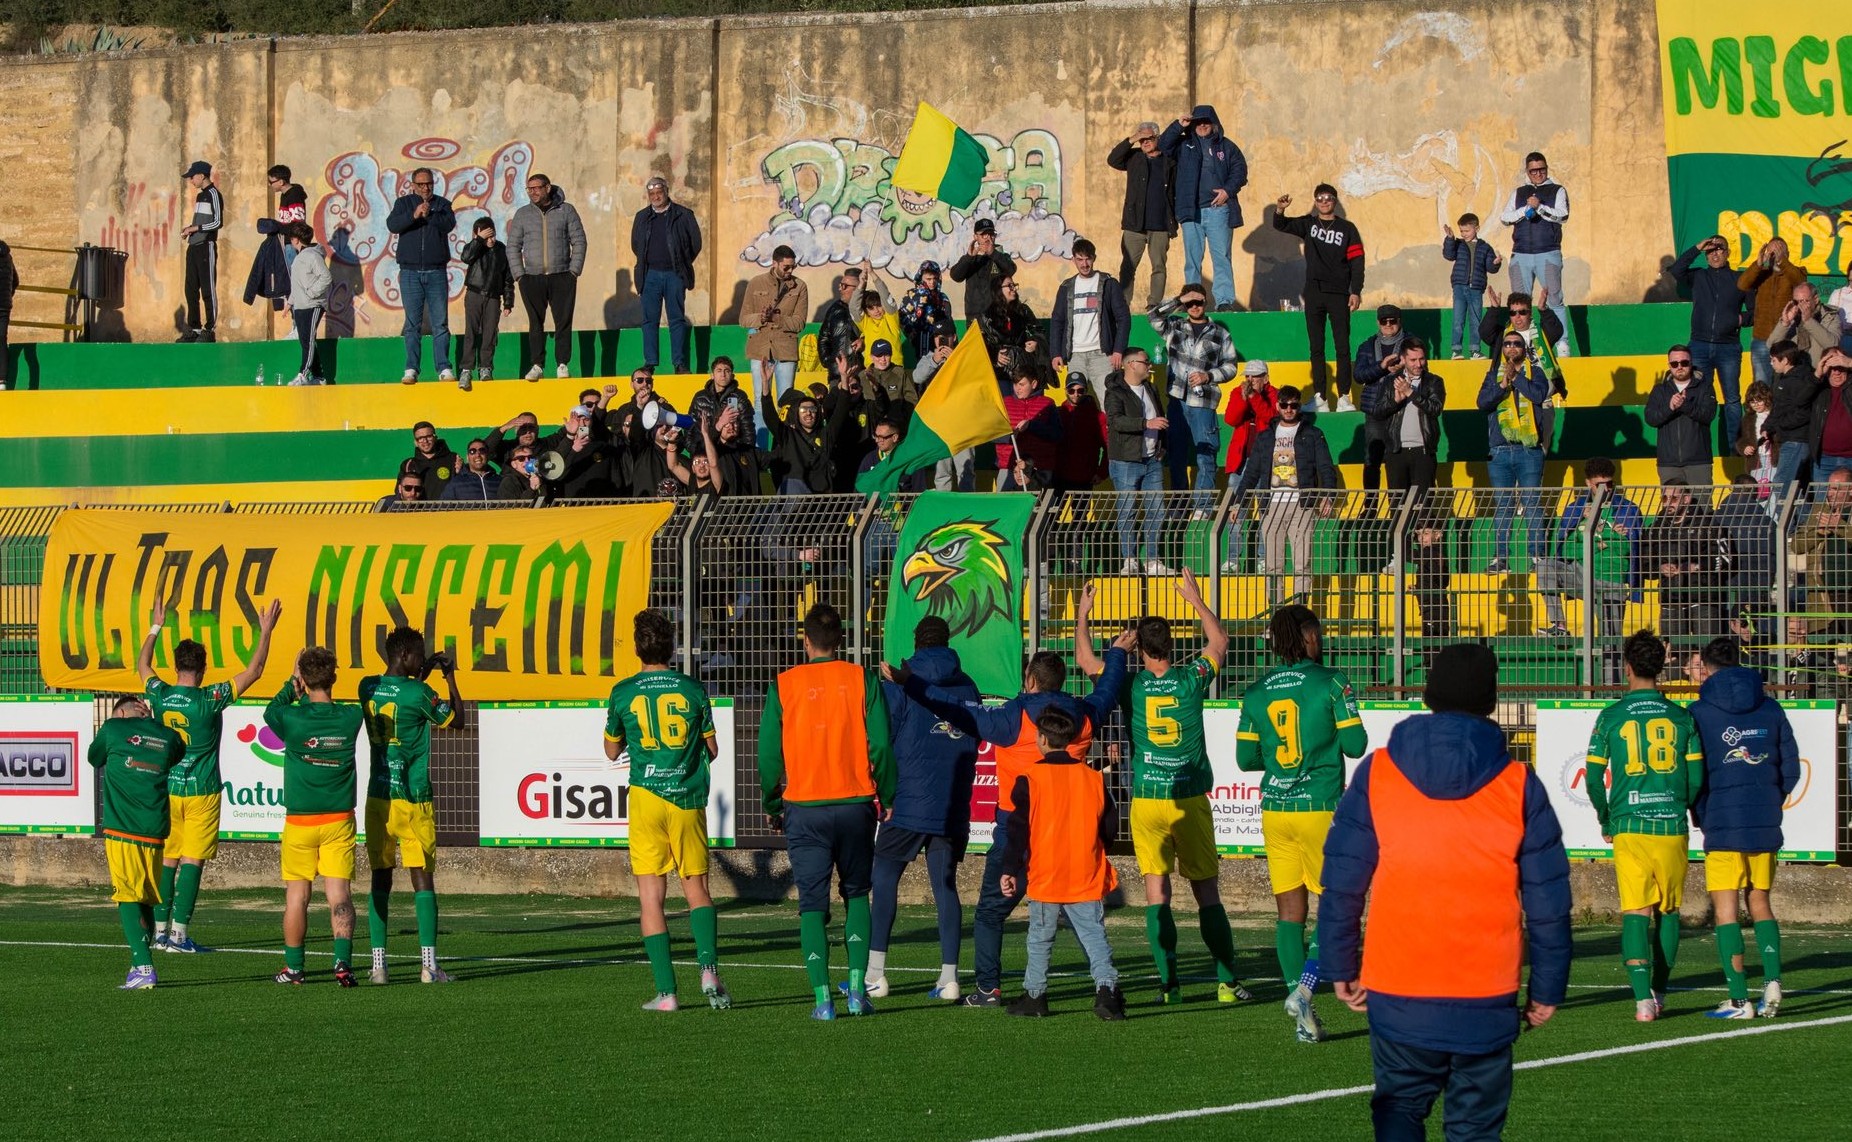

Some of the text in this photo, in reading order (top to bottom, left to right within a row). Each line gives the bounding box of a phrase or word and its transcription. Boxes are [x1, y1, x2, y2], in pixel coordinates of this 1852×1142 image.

[1311, 224, 1344, 247] GCDS
[59, 532, 628, 678] ULTRAS NISCEMI
[630, 693, 690, 751] 16
[1145, 696, 1182, 748] 5
[1267, 698, 1303, 769] 9
[1619, 717, 1678, 776] 18
[1212, 803, 1263, 817] Abbigli
